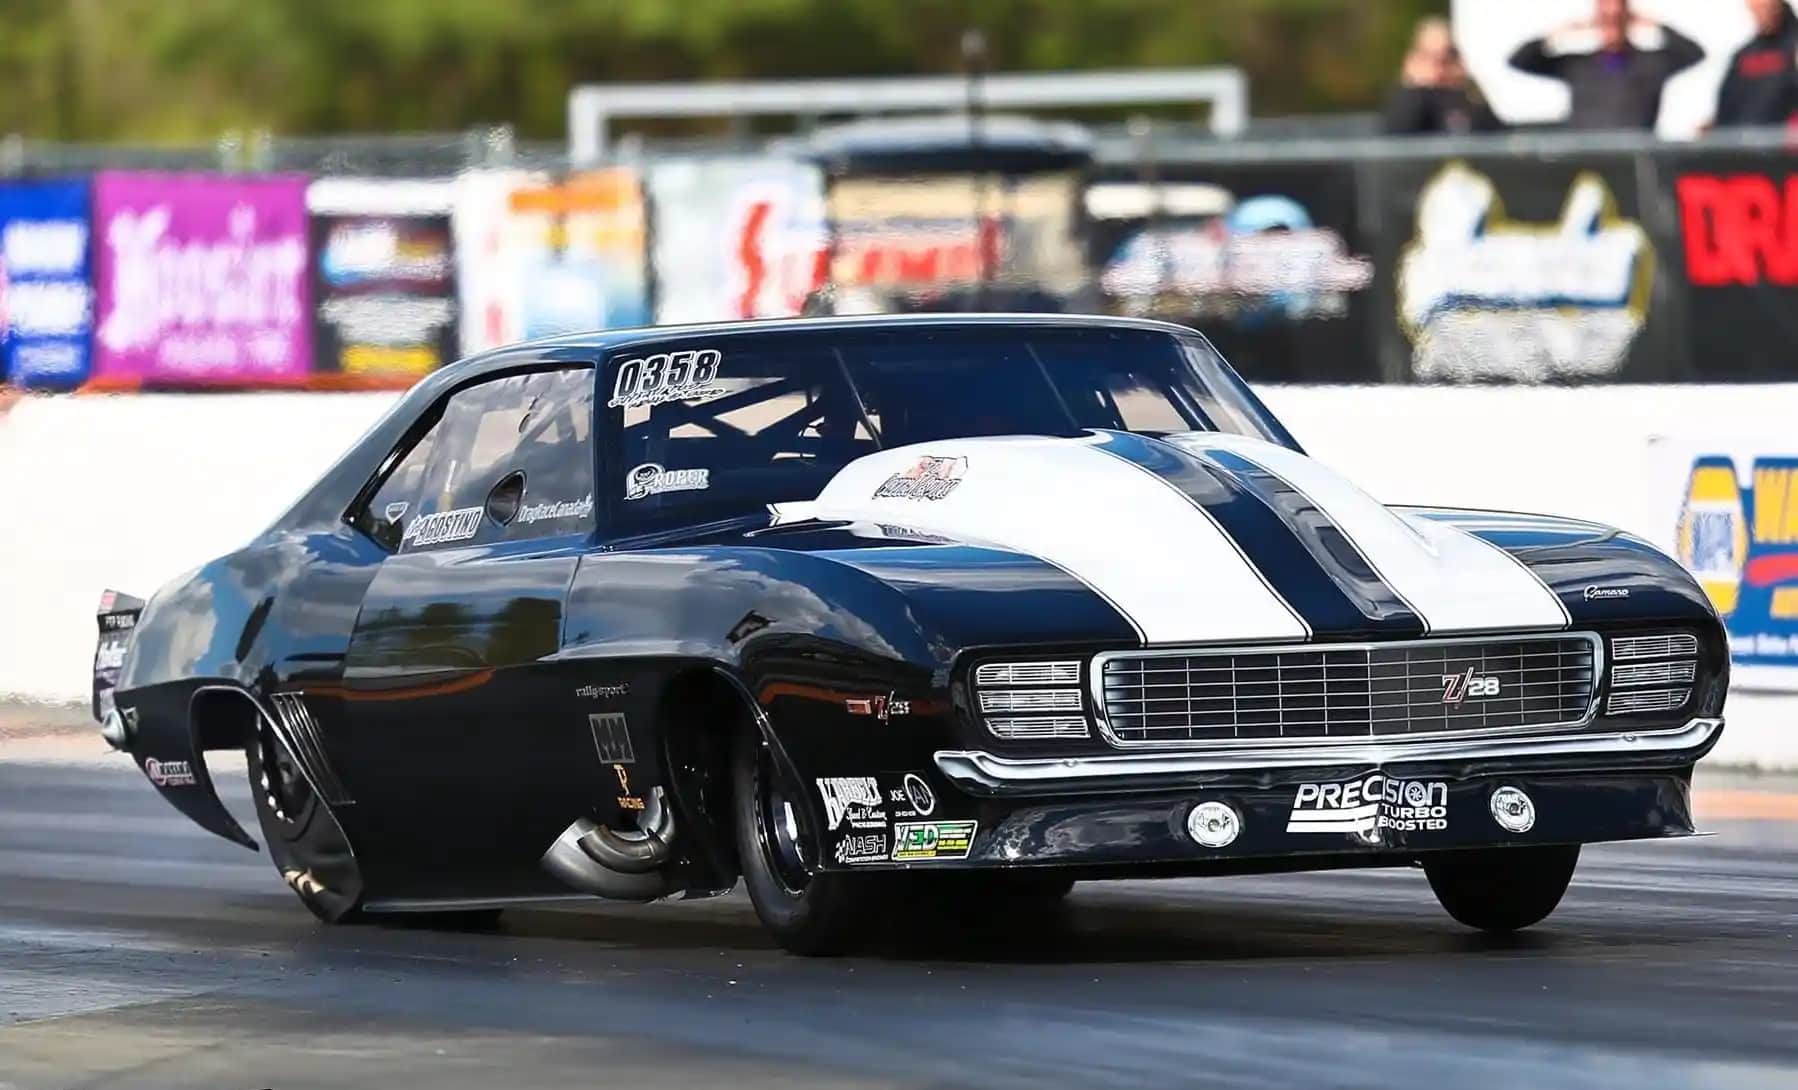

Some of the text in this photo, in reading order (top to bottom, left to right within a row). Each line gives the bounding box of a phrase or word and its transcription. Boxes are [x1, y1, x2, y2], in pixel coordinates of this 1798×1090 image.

[613, 350, 721, 398] 0358
[1584, 585, 1629, 601] Camaro
[1442, 667, 1499, 704] Z/28
[890, 789, 906, 801] JOE
[1381, 803, 1447, 818] TURBO
[1378, 816, 1448, 831] BOOSTED
[845, 833, 887, 856] NASH
